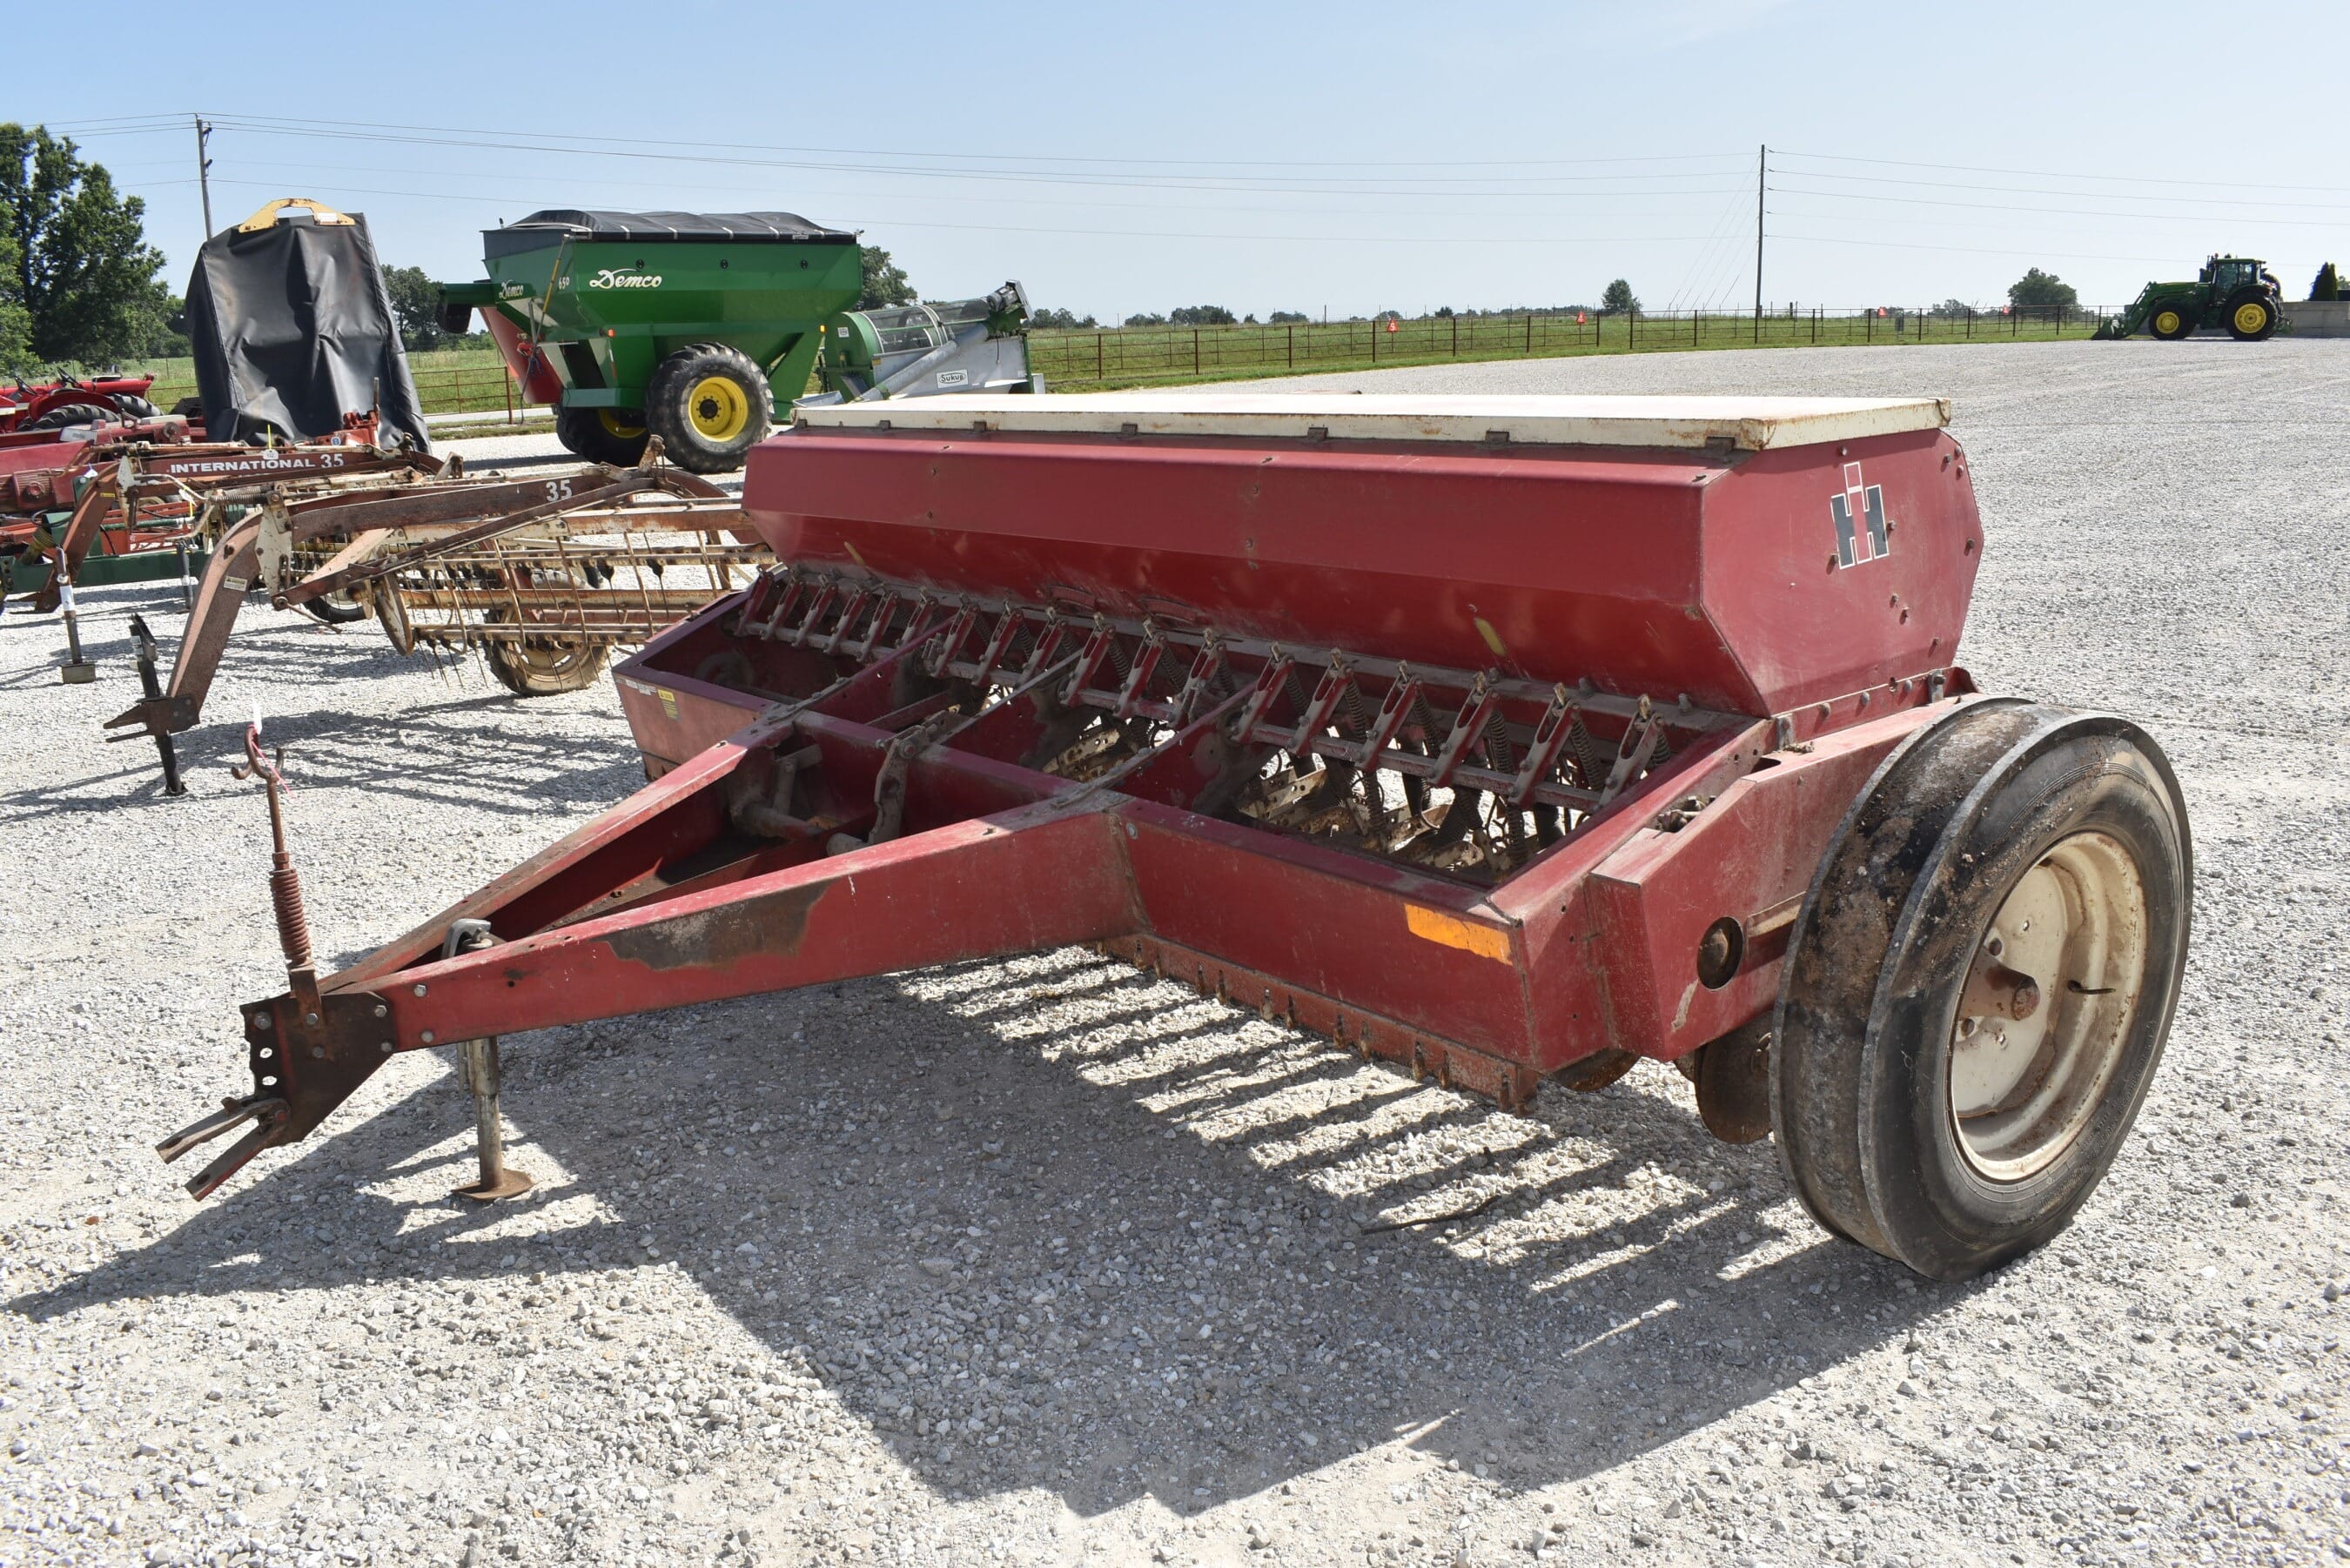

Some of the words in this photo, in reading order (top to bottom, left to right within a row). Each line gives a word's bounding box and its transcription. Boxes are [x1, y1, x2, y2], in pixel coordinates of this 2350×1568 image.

[499, 278, 524, 300] Demco
[589, 268, 662, 290] Demco
[170, 459, 316, 473] INTERNATIONAL
[320, 453, 344, 468] 35
[546, 479, 573, 502] 35
